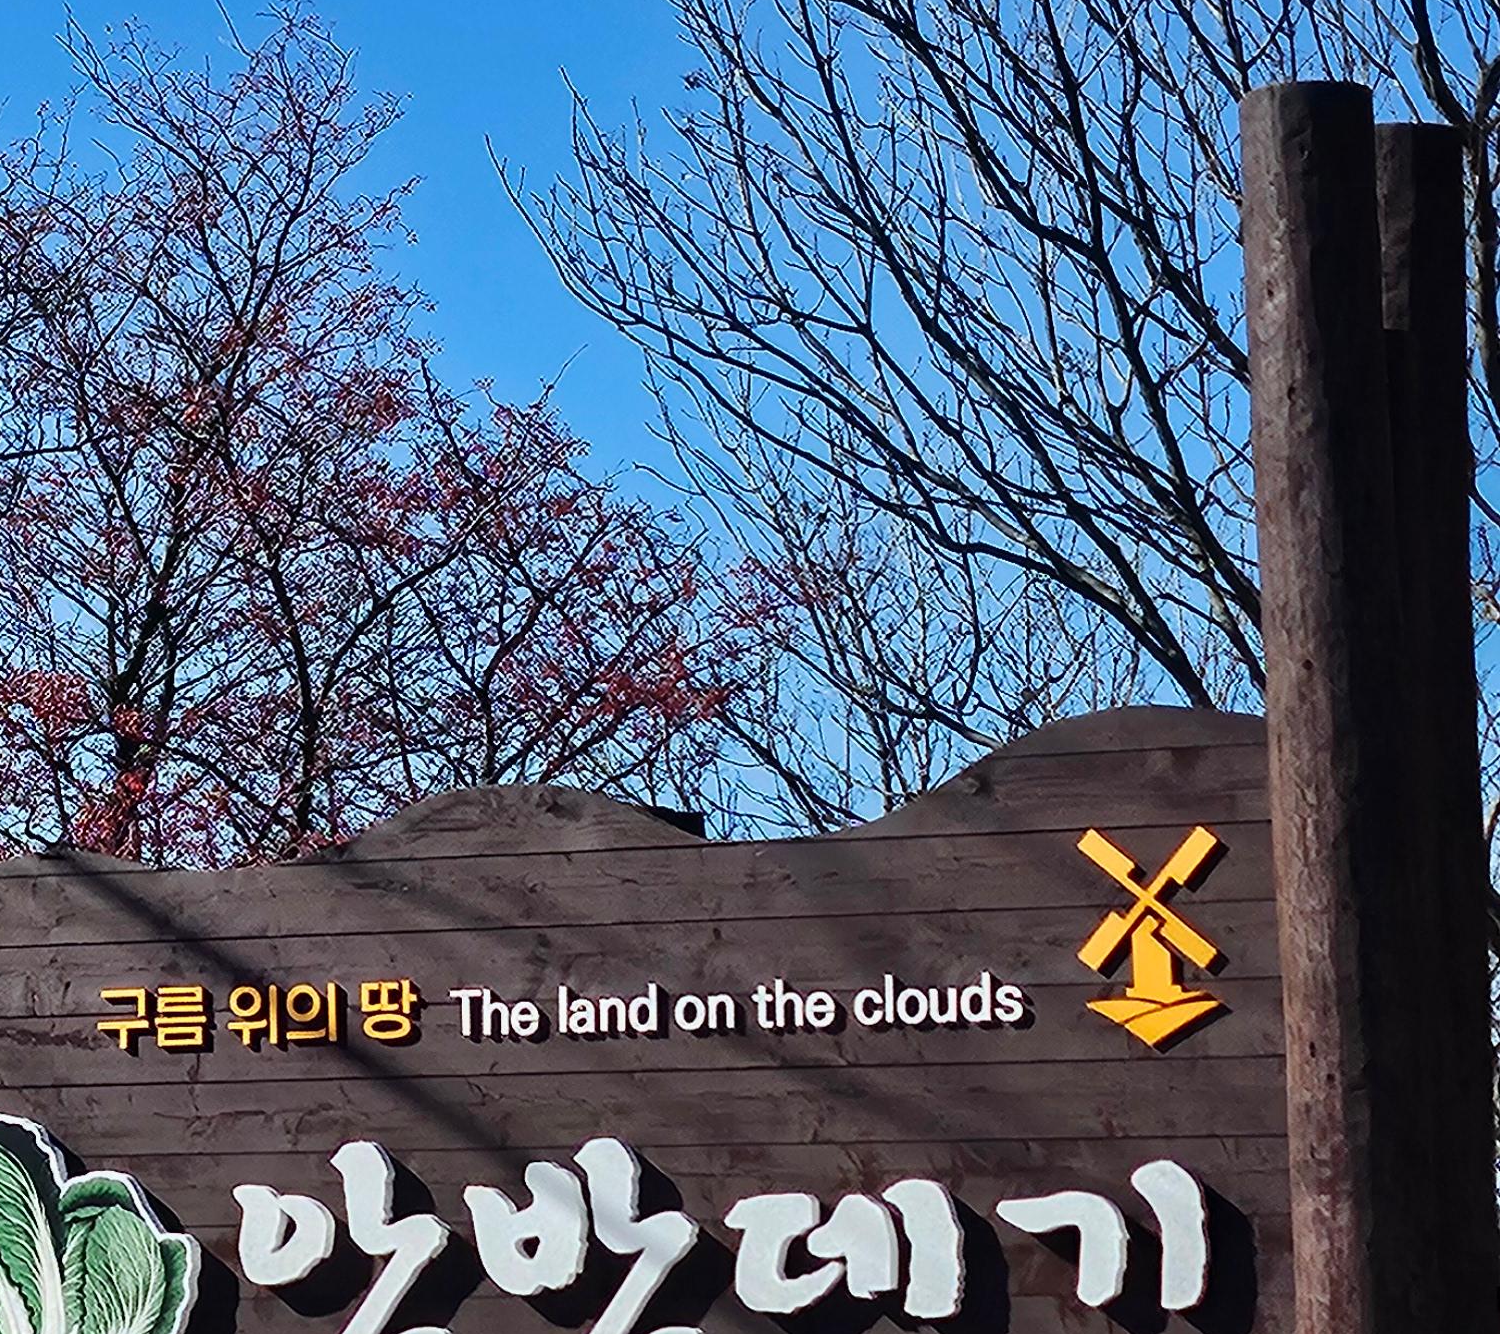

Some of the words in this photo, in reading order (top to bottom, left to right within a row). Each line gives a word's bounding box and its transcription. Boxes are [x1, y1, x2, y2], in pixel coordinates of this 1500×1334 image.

[97, 985, 207, 1049] 구름
[227, 982, 339, 1047] 위의
[360, 979, 418, 1040] 땅
[449, 987, 540, 1037] The
[557, 982, 658, 1034] land
[674, 993, 735, 1032] on
[751, 978, 836, 1029] the
[853, 971, 1025, 1027] clouds
